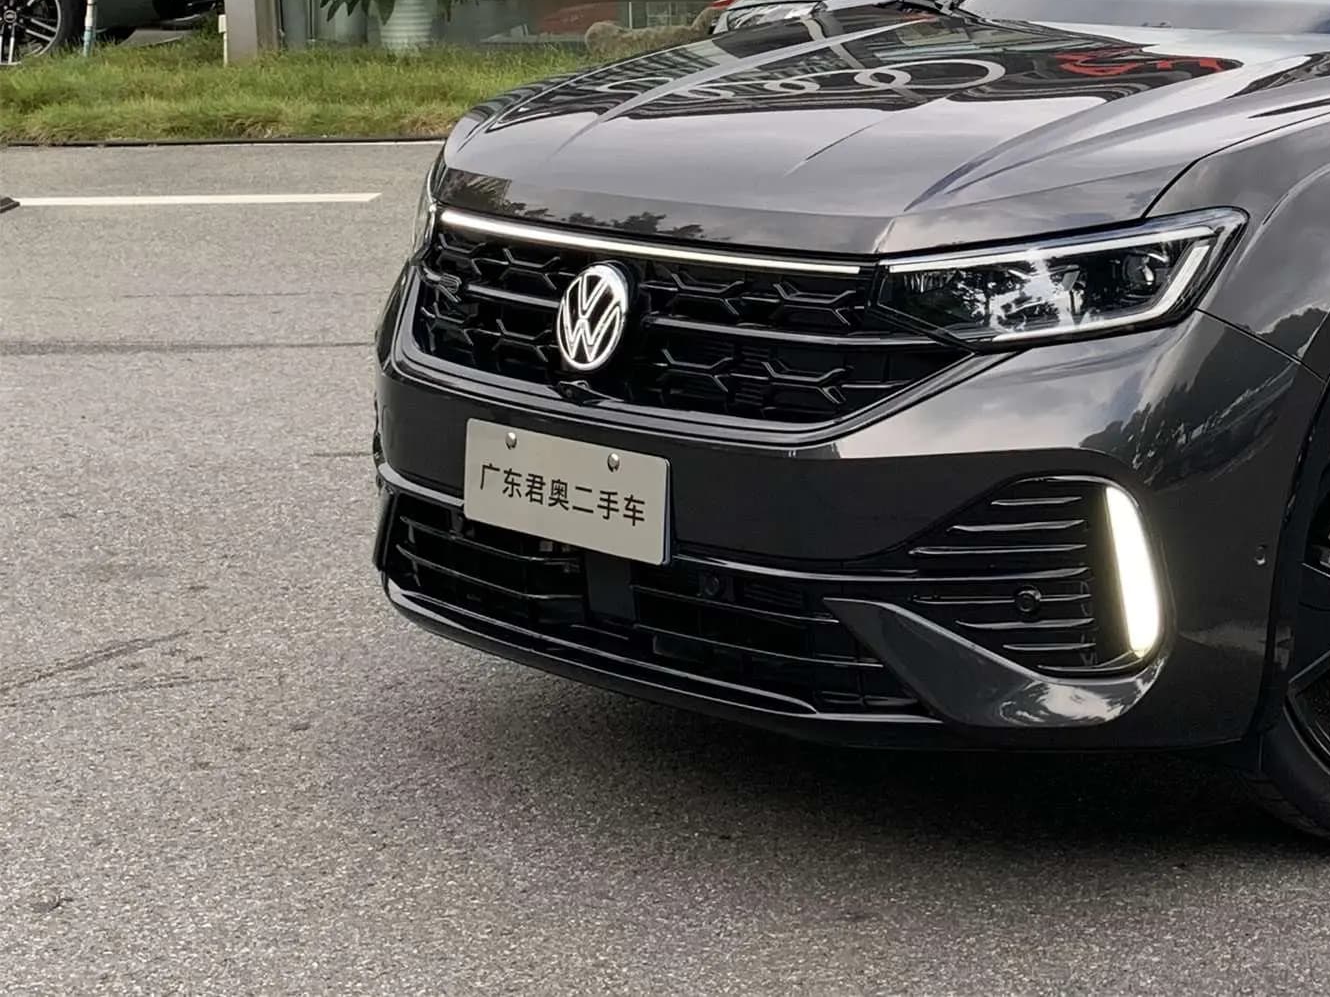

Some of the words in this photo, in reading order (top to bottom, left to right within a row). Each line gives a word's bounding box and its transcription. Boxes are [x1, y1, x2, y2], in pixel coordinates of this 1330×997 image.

[556, 264, 628, 371] VW
[479, 462, 646, 527] 广东君奥二手车
